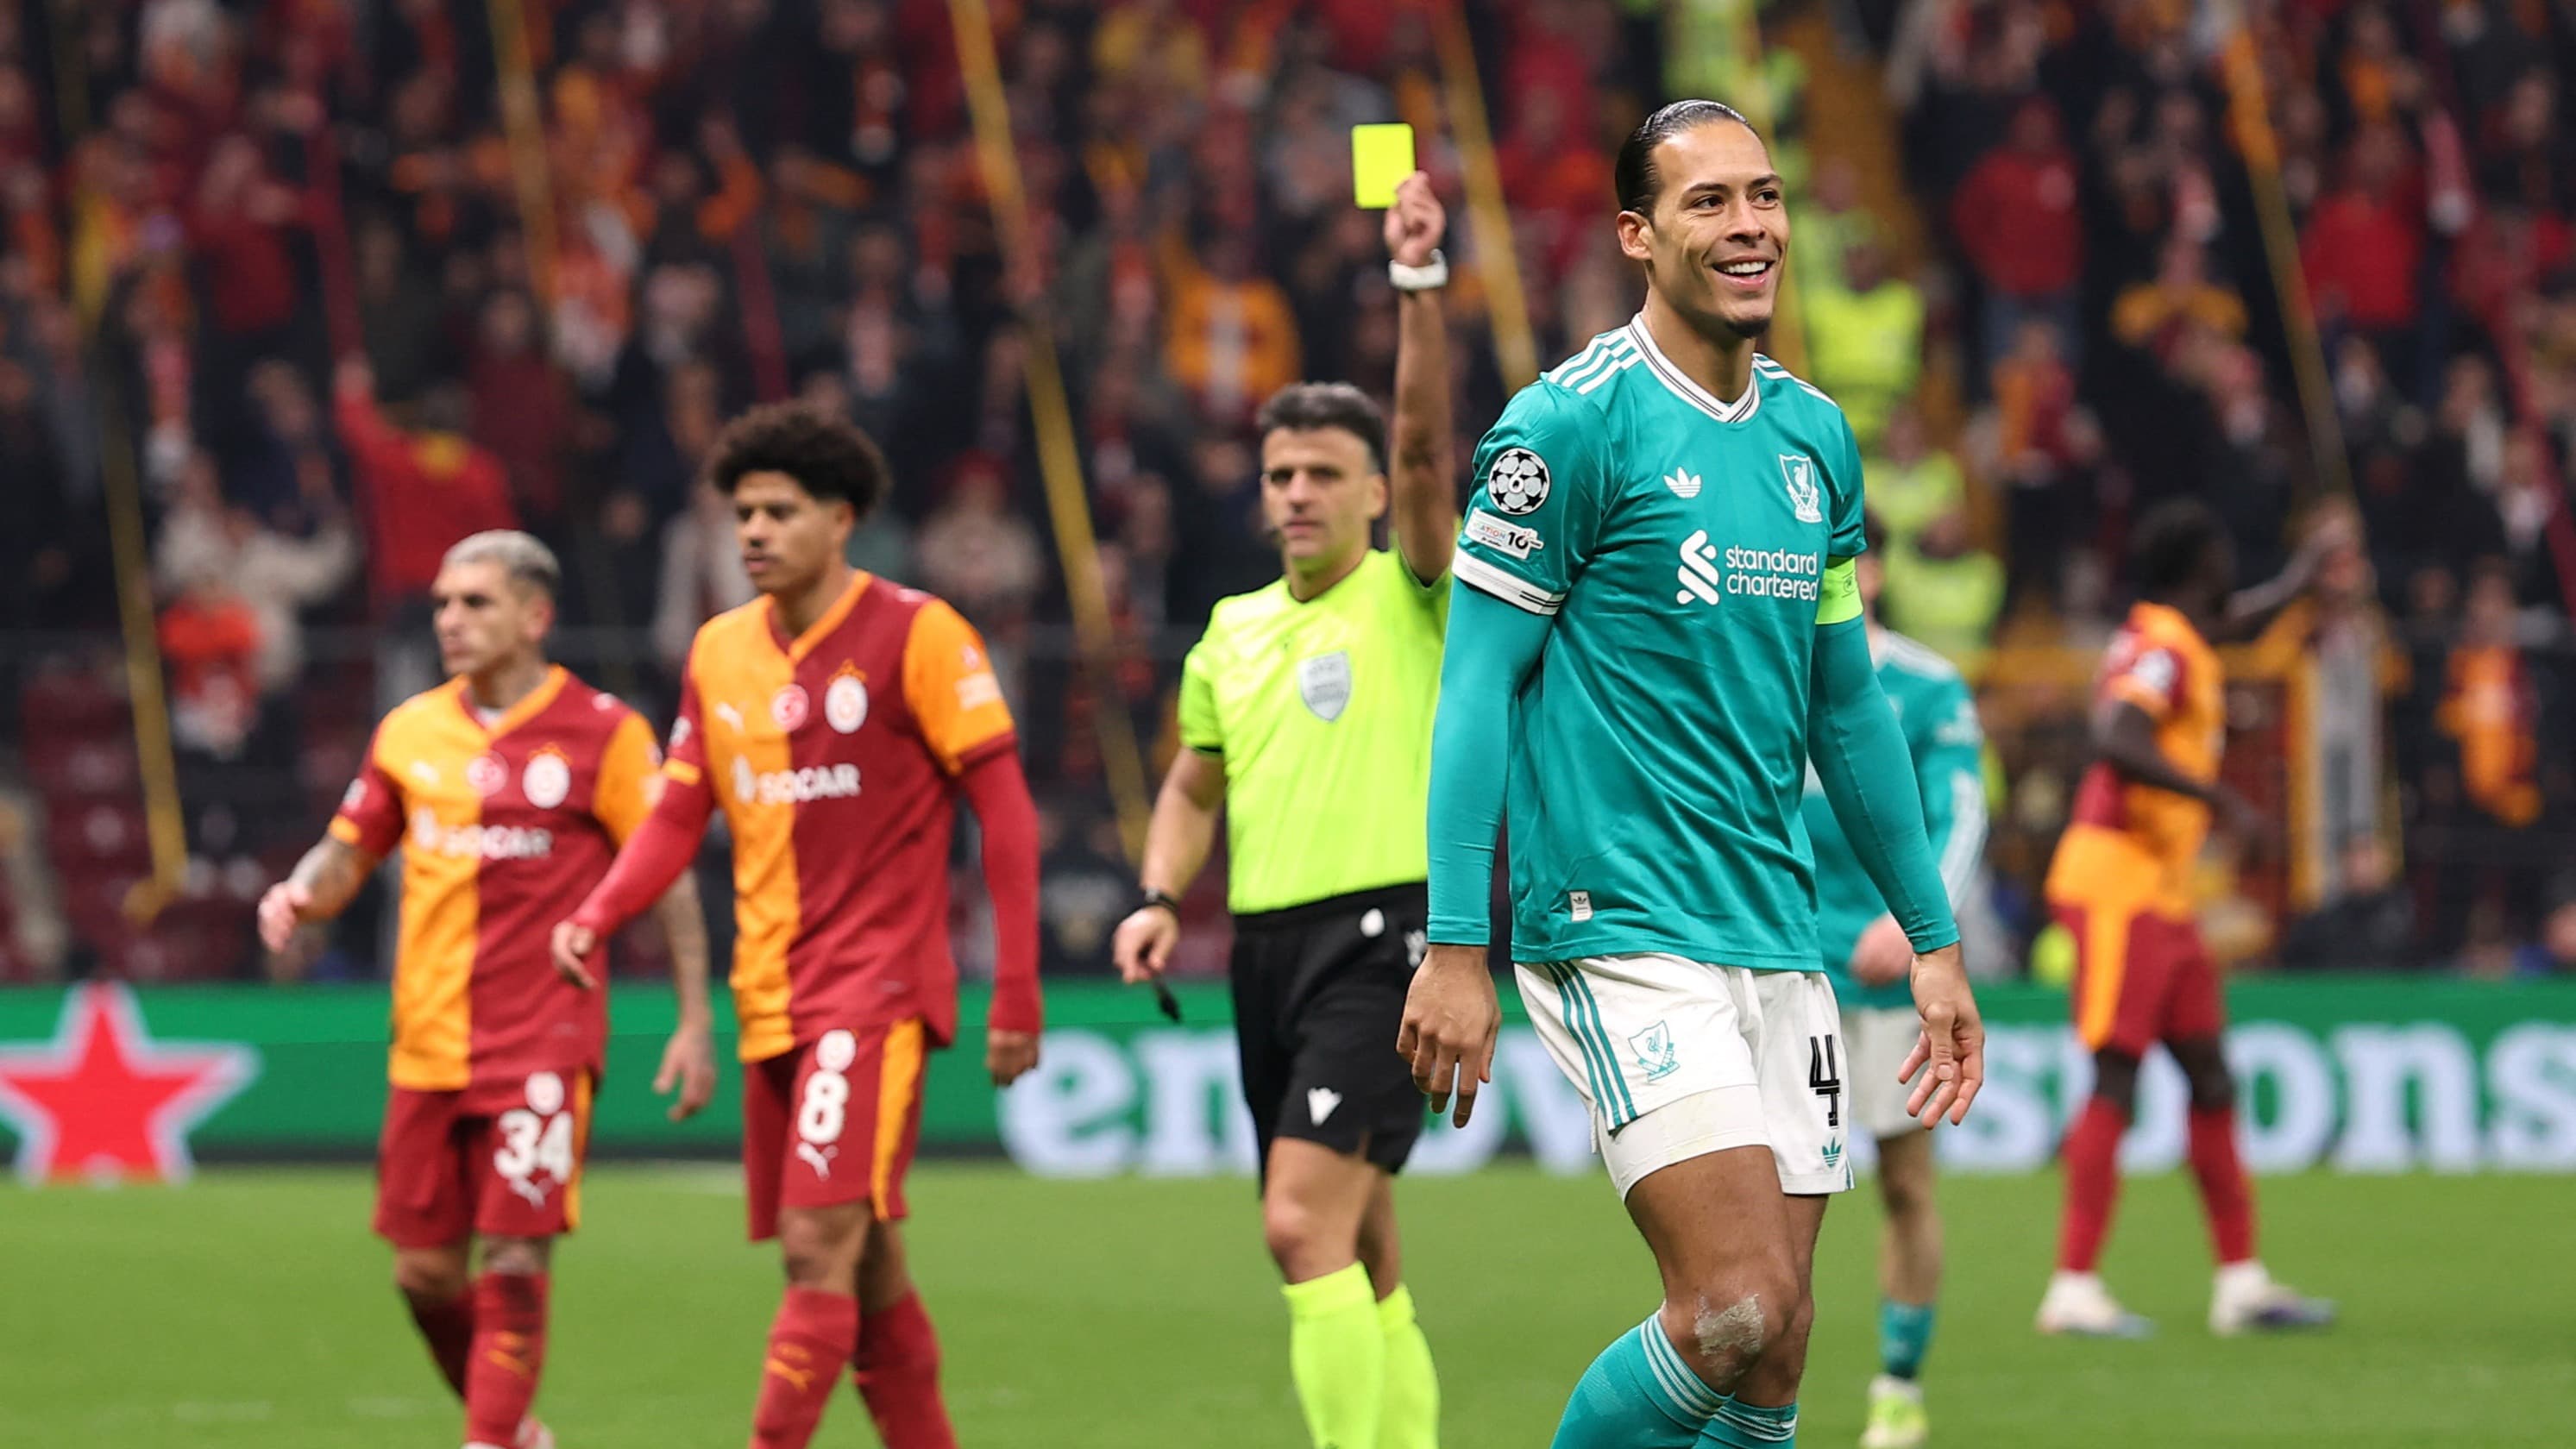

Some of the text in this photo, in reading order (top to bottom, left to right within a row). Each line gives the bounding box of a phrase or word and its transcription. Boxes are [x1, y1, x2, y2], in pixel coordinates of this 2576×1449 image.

[1508, 468, 1524, 493] 6
[1725, 544, 1818, 576] standard
[1726, 570, 1819, 601] chartered
[797, 1069, 850, 1145] 8
[1808, 1034, 1841, 1128] 4
[493, 1108, 575, 1186] 34
